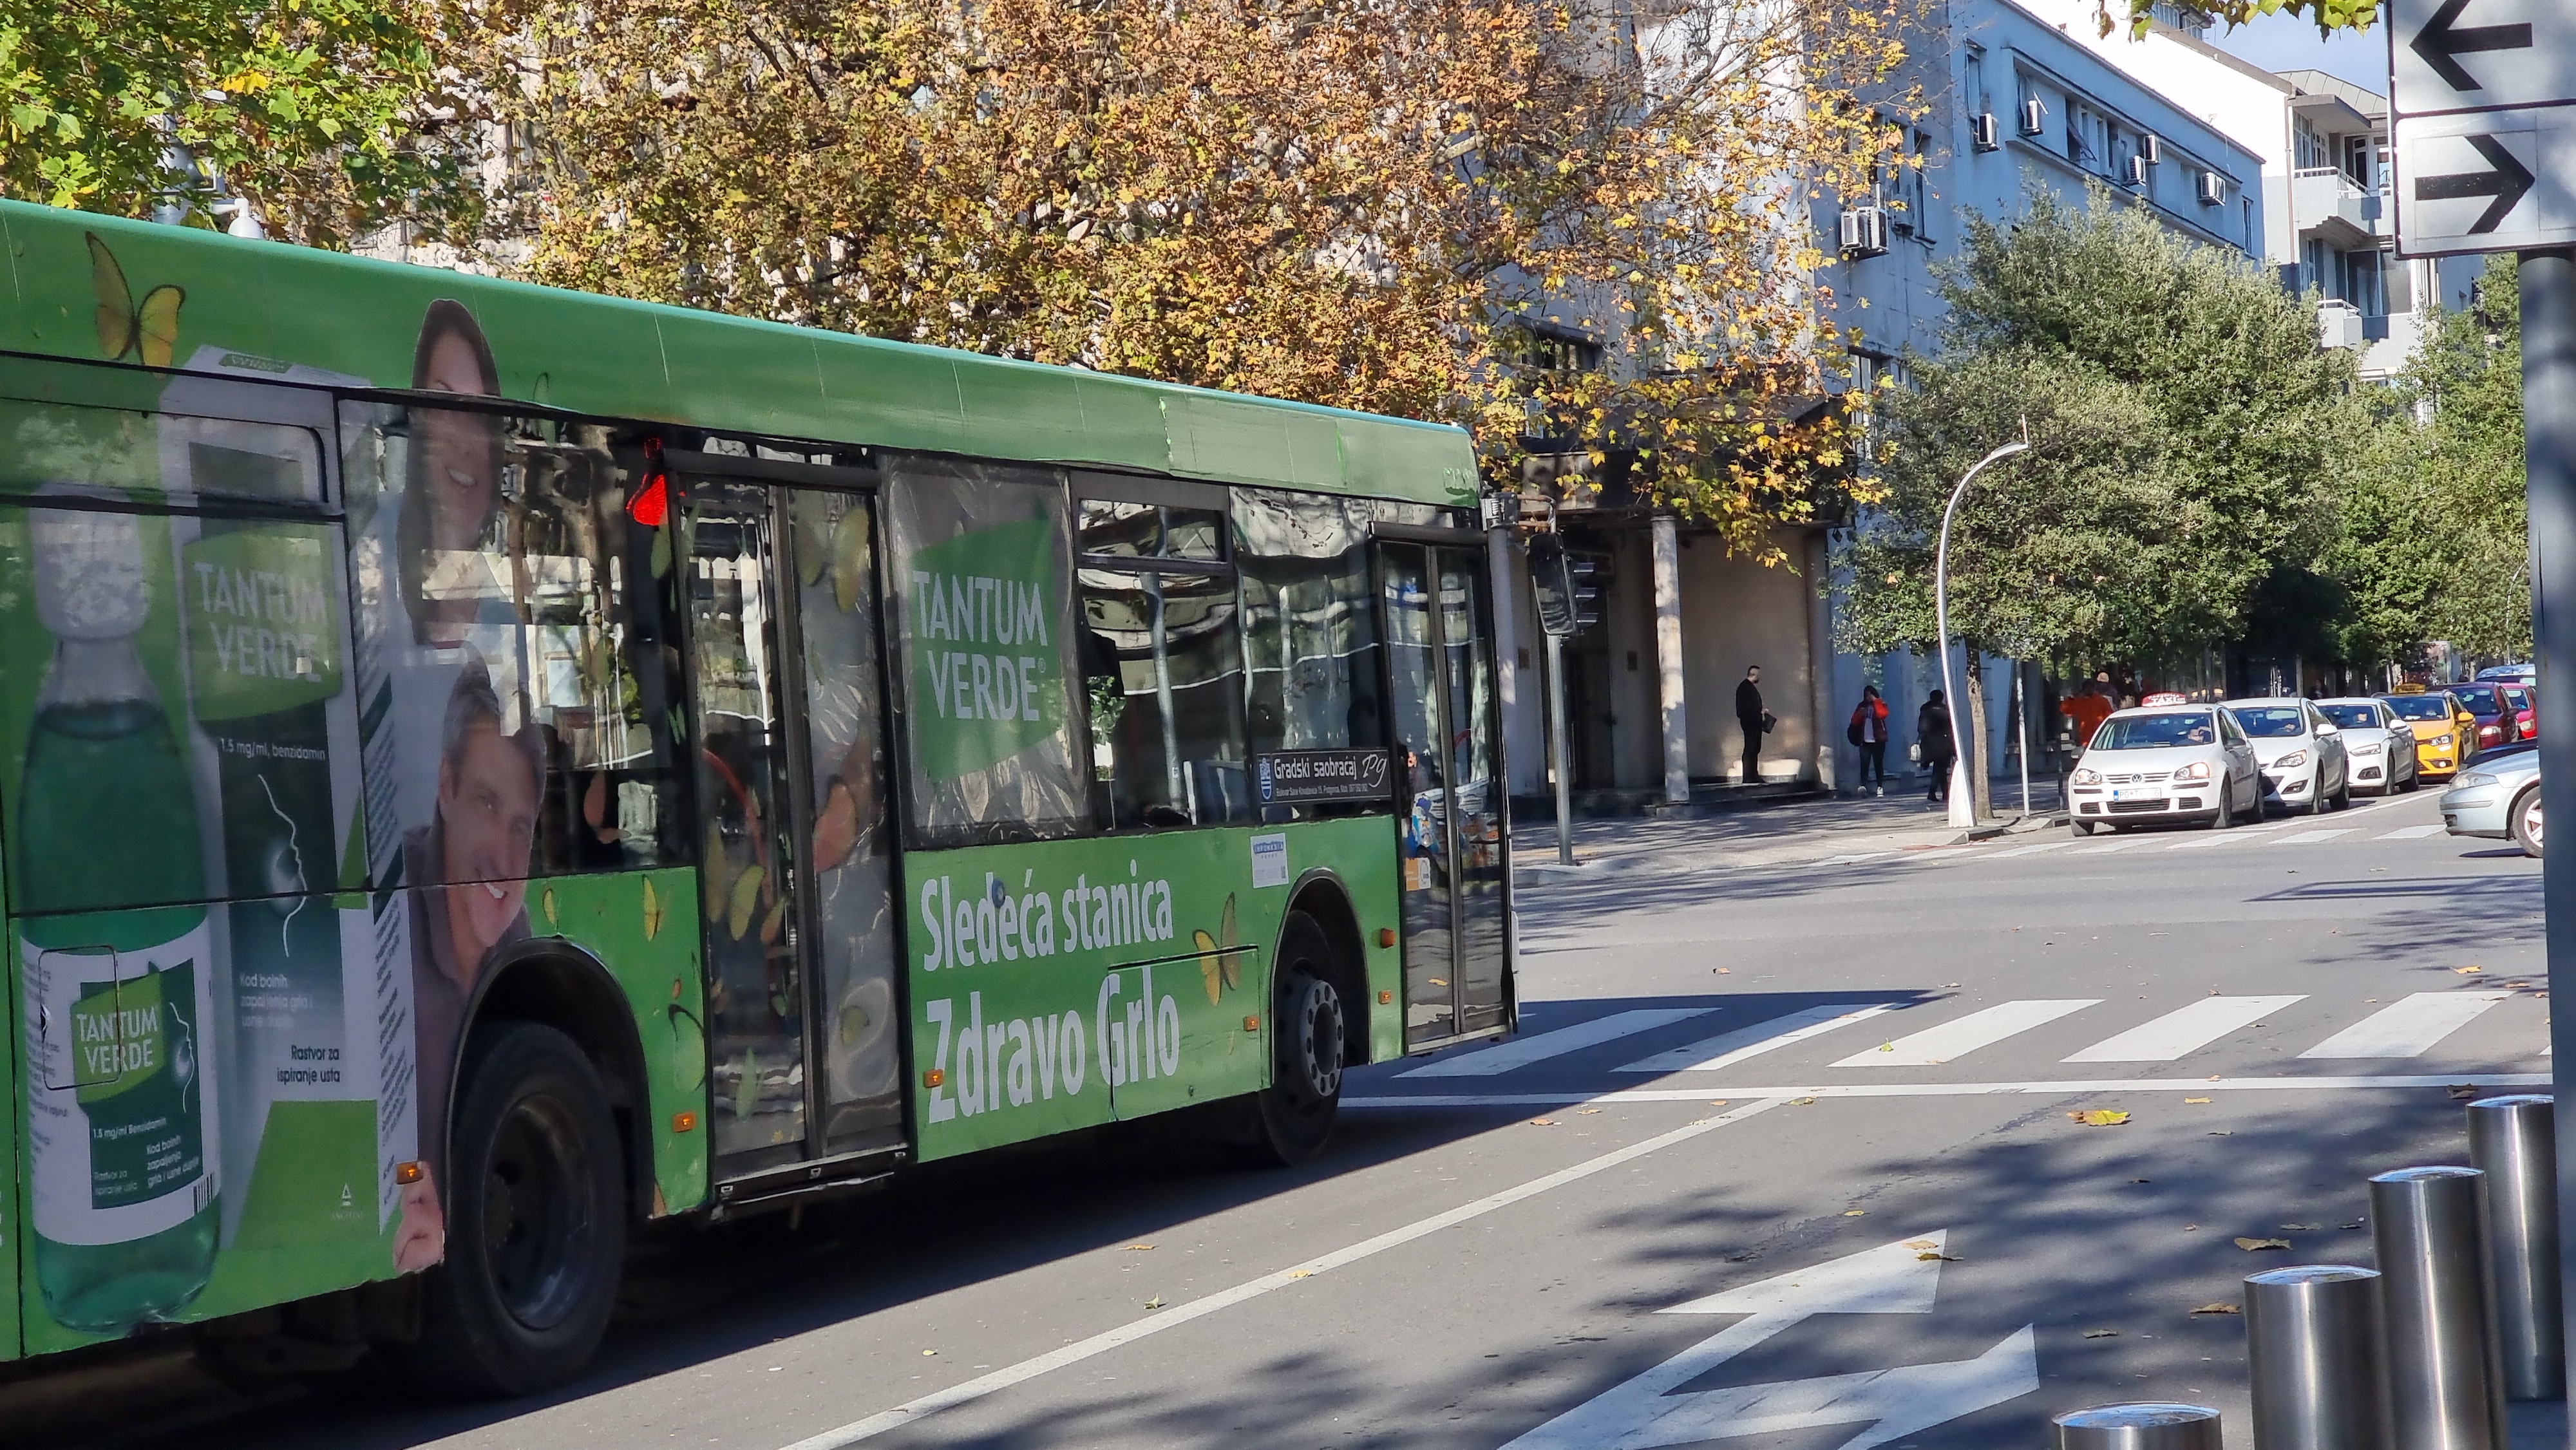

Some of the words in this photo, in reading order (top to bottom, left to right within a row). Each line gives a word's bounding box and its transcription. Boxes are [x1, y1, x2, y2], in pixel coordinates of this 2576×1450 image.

[194, 562, 328, 627] TANTUM
[913, 570, 1048, 646] TANTUM
[2151, 696, 2177, 704] TAXI
[271, 743, 327, 760] benzidamin
[1274, 757, 1311, 780] Gradski
[1313, 756, 1358, 780] saobraćaj
[921, 869, 1055, 972] Sledeća
[1062, 859, 1173, 953] stanica
[77, 1004, 158, 1042] TANTUM
[84, 1039, 153, 1074] VERDE
[290, 1045, 325, 1060] Rastvor
[328, 1048, 340, 1060] za
[927, 991, 1085, 1124] Zdravo
[1097, 966, 1180, 1087] Grlo
[277, 1066, 317, 1085] ispiranje
[319, 1068, 341, 1082] usta
[104, 1126, 127, 1140] mg/ml
